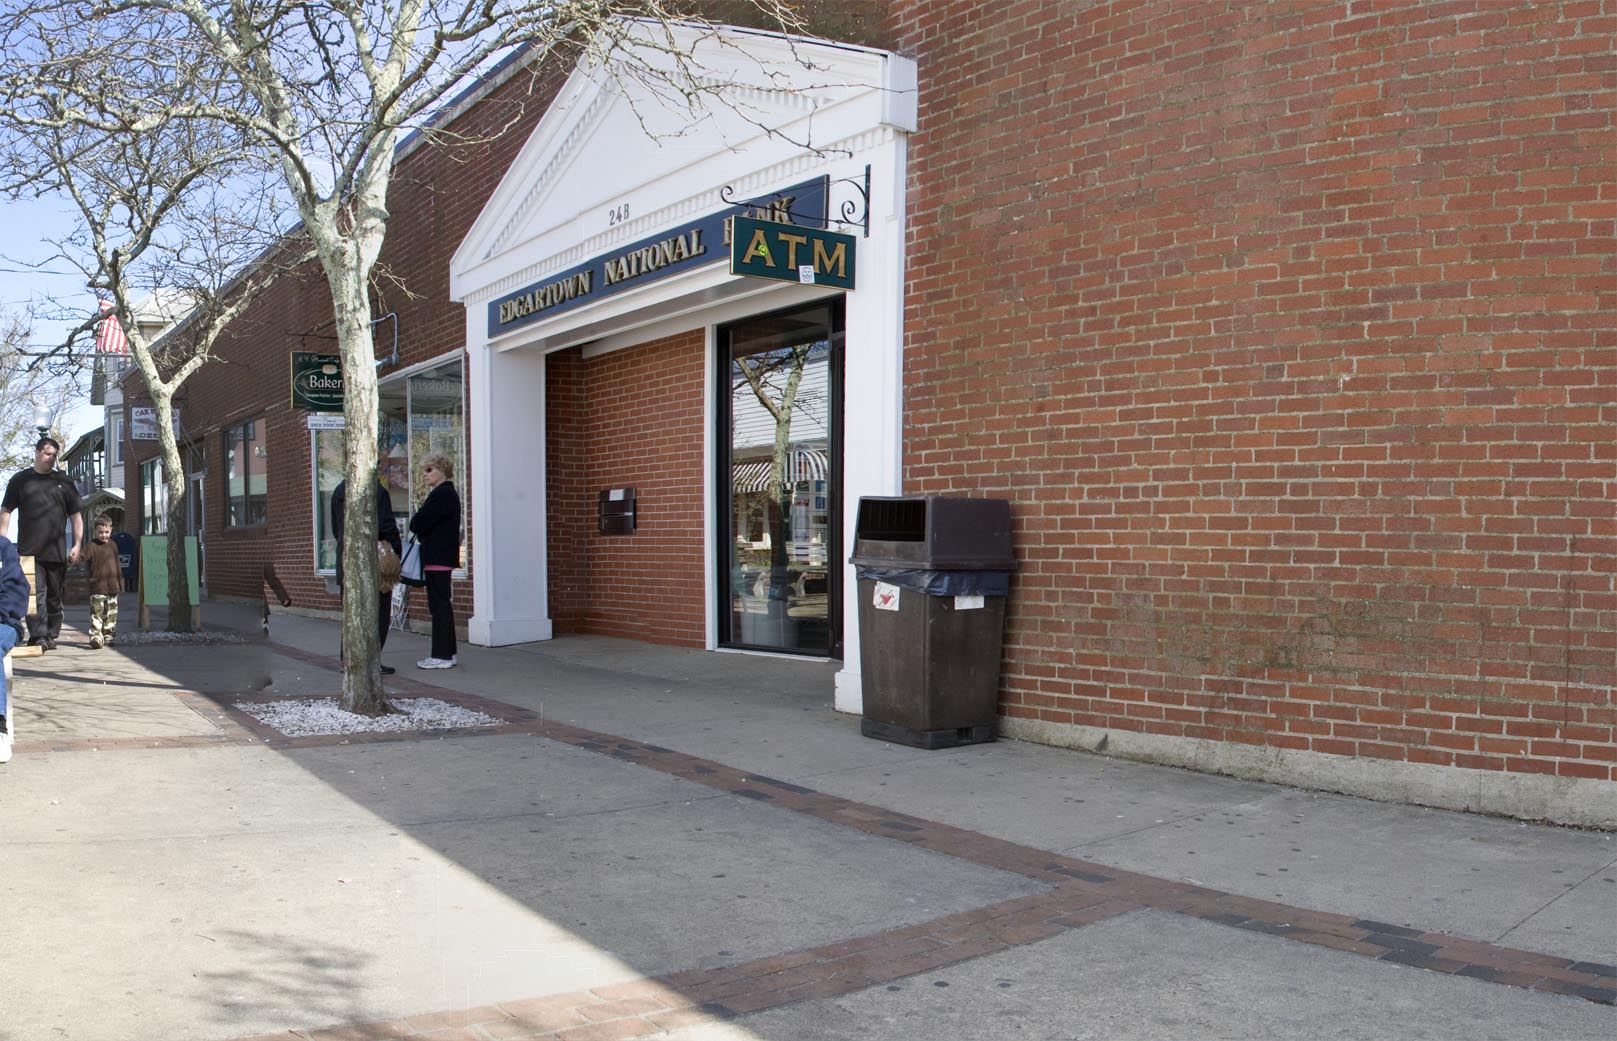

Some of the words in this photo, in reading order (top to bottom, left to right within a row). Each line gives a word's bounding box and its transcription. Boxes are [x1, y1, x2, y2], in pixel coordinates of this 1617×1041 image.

[499, 269, 594, 325] EDGARTOWN
[603, 228, 706, 286] NATIONAL
[724, 195, 795, 246] NK
[741, 229, 847, 279] ATM
[309, 374, 343, 389] Baker
[135, 408, 150, 417] OAK
